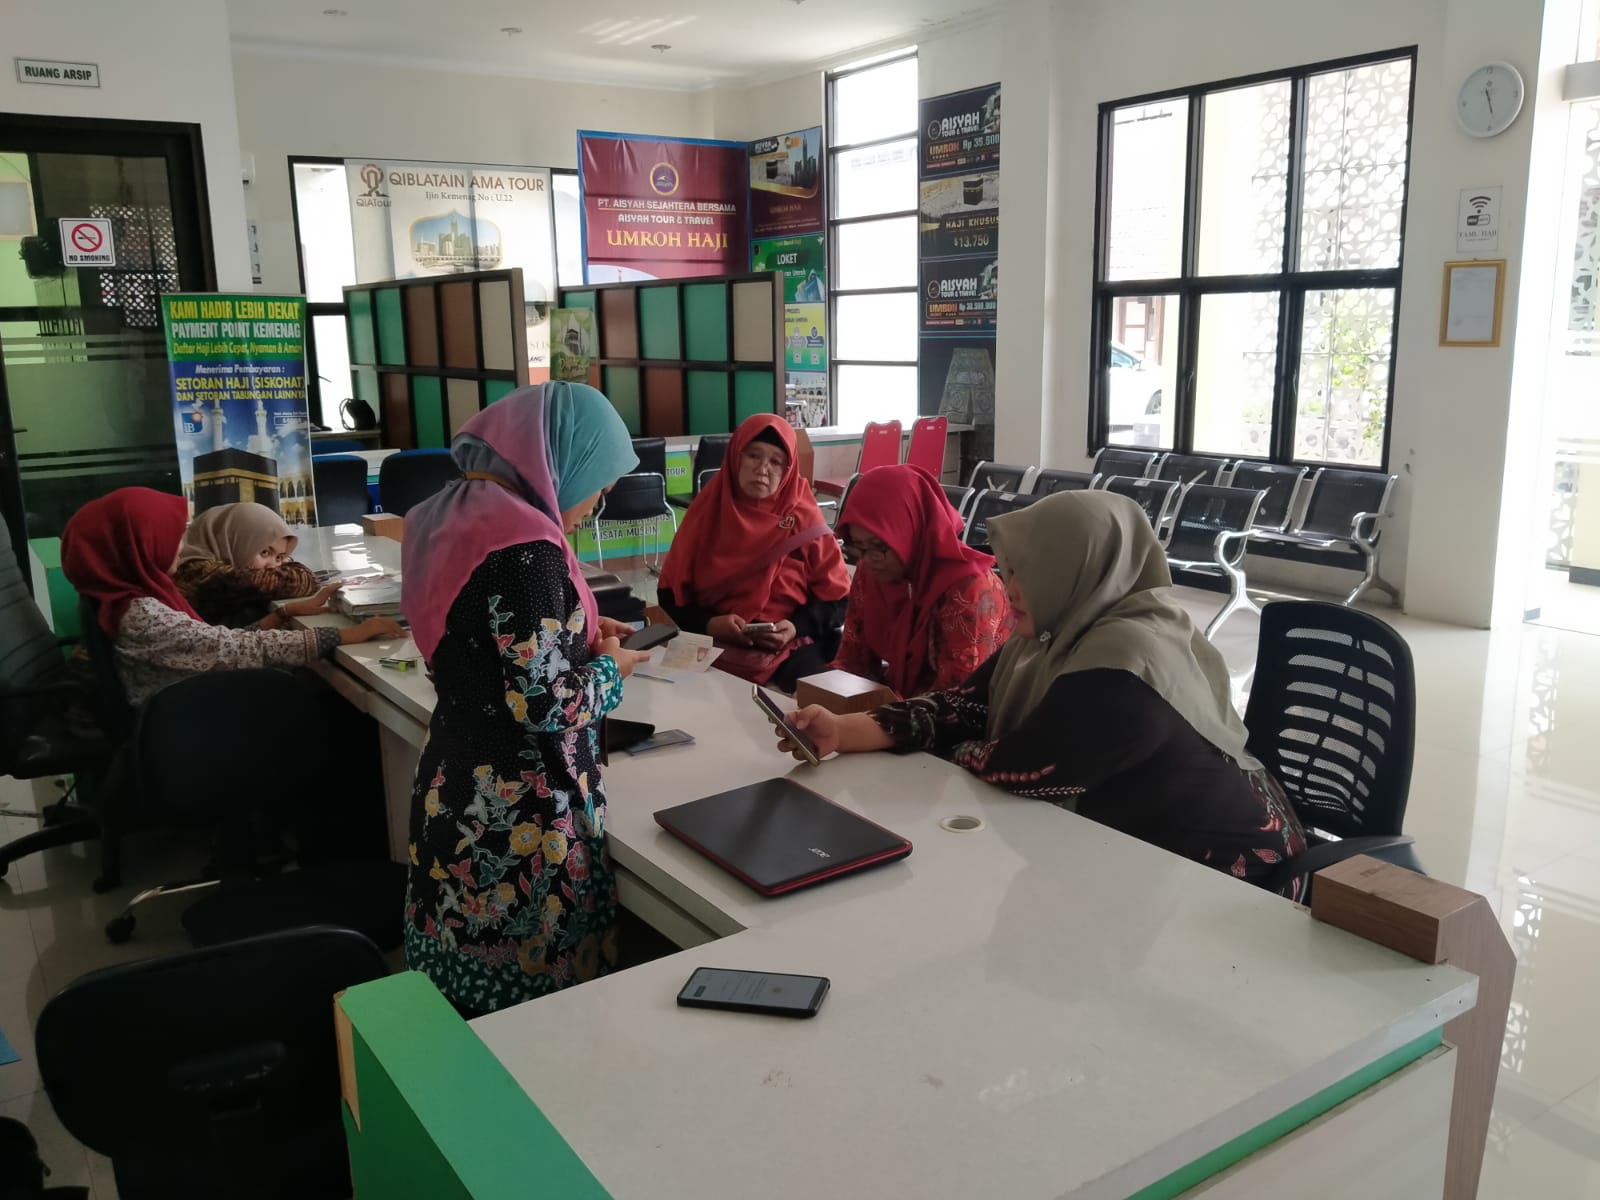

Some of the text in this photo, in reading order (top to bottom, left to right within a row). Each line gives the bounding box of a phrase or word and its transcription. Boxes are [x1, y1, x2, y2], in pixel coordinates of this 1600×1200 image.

[24, 65, 92, 81] RUANG ARSIP
[941, 111, 980, 131] AISYAH
[388, 172, 545, 192] QIBLATAIN AMA TOUR
[598, 198, 737, 212] PT. AISYAH SEJAHTERA BERSAMA
[651, 215, 675, 224] TOUR
[685, 217, 714, 225] TRAVEL
[945, 219, 966, 229] HAJI
[607, 230, 729, 252] UMROH HAJI
[777, 253, 798, 265] LOKET
[940, 277, 978, 292] AISYAH
[169, 301, 300, 320] KAMI HADIR LEBIH DEKAT
[171, 322, 301, 338] PAYMENT POINT KEMENAG
[234, 364, 281, 375] Pembayaran
[175, 378, 223, 391] SETORAN
[225, 377, 250, 389] HAJI
[175, 391, 195, 402] DAN
[195, 391, 231, 401] SETORAN
[232, 391, 273, 400] TABUNGAN
